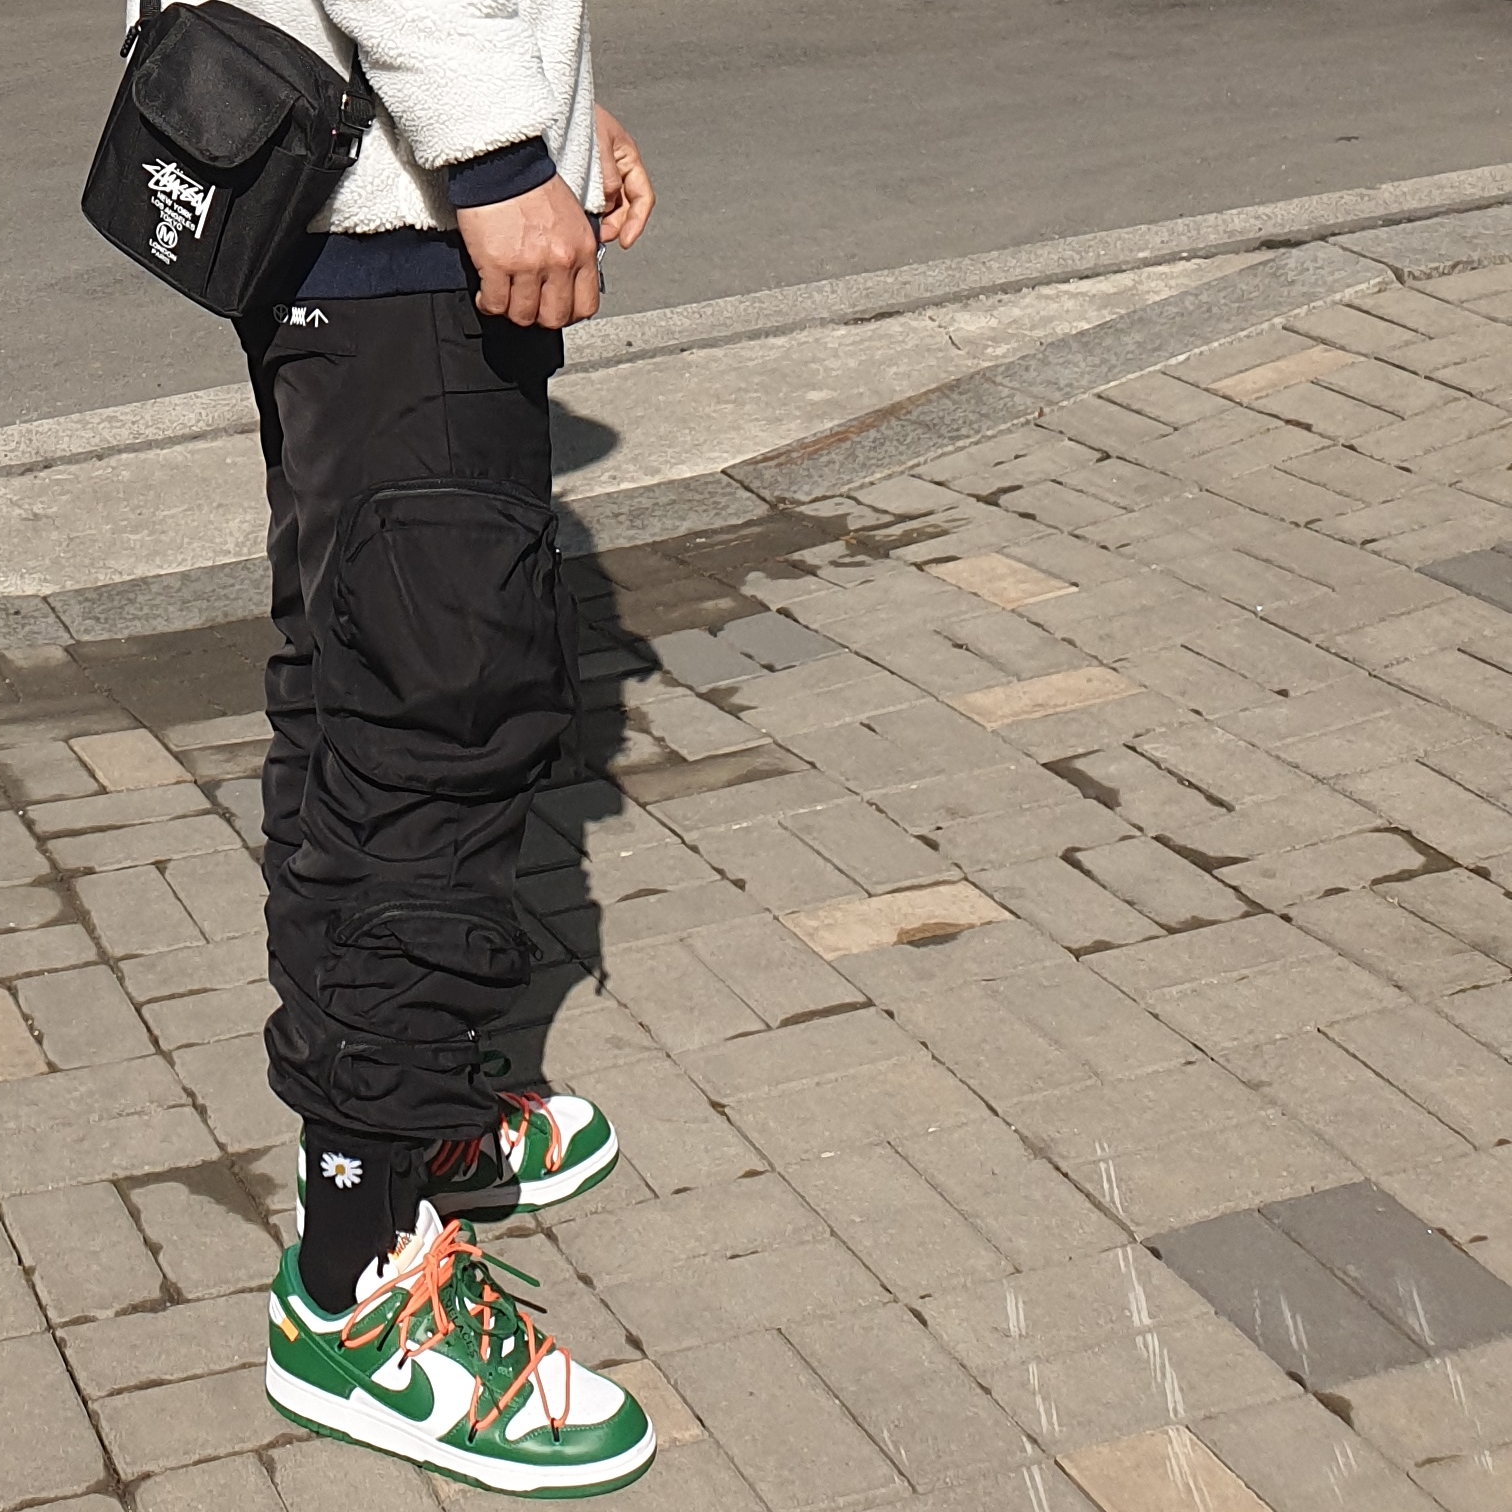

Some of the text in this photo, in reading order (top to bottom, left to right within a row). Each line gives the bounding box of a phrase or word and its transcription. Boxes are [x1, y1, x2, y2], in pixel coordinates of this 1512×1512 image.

[150, 195, 165, 210] LOS
[156, 191, 193, 220] NEW YORK
[159, 210, 183, 231] TOKYO
[149, 238, 178, 262] LONDON
